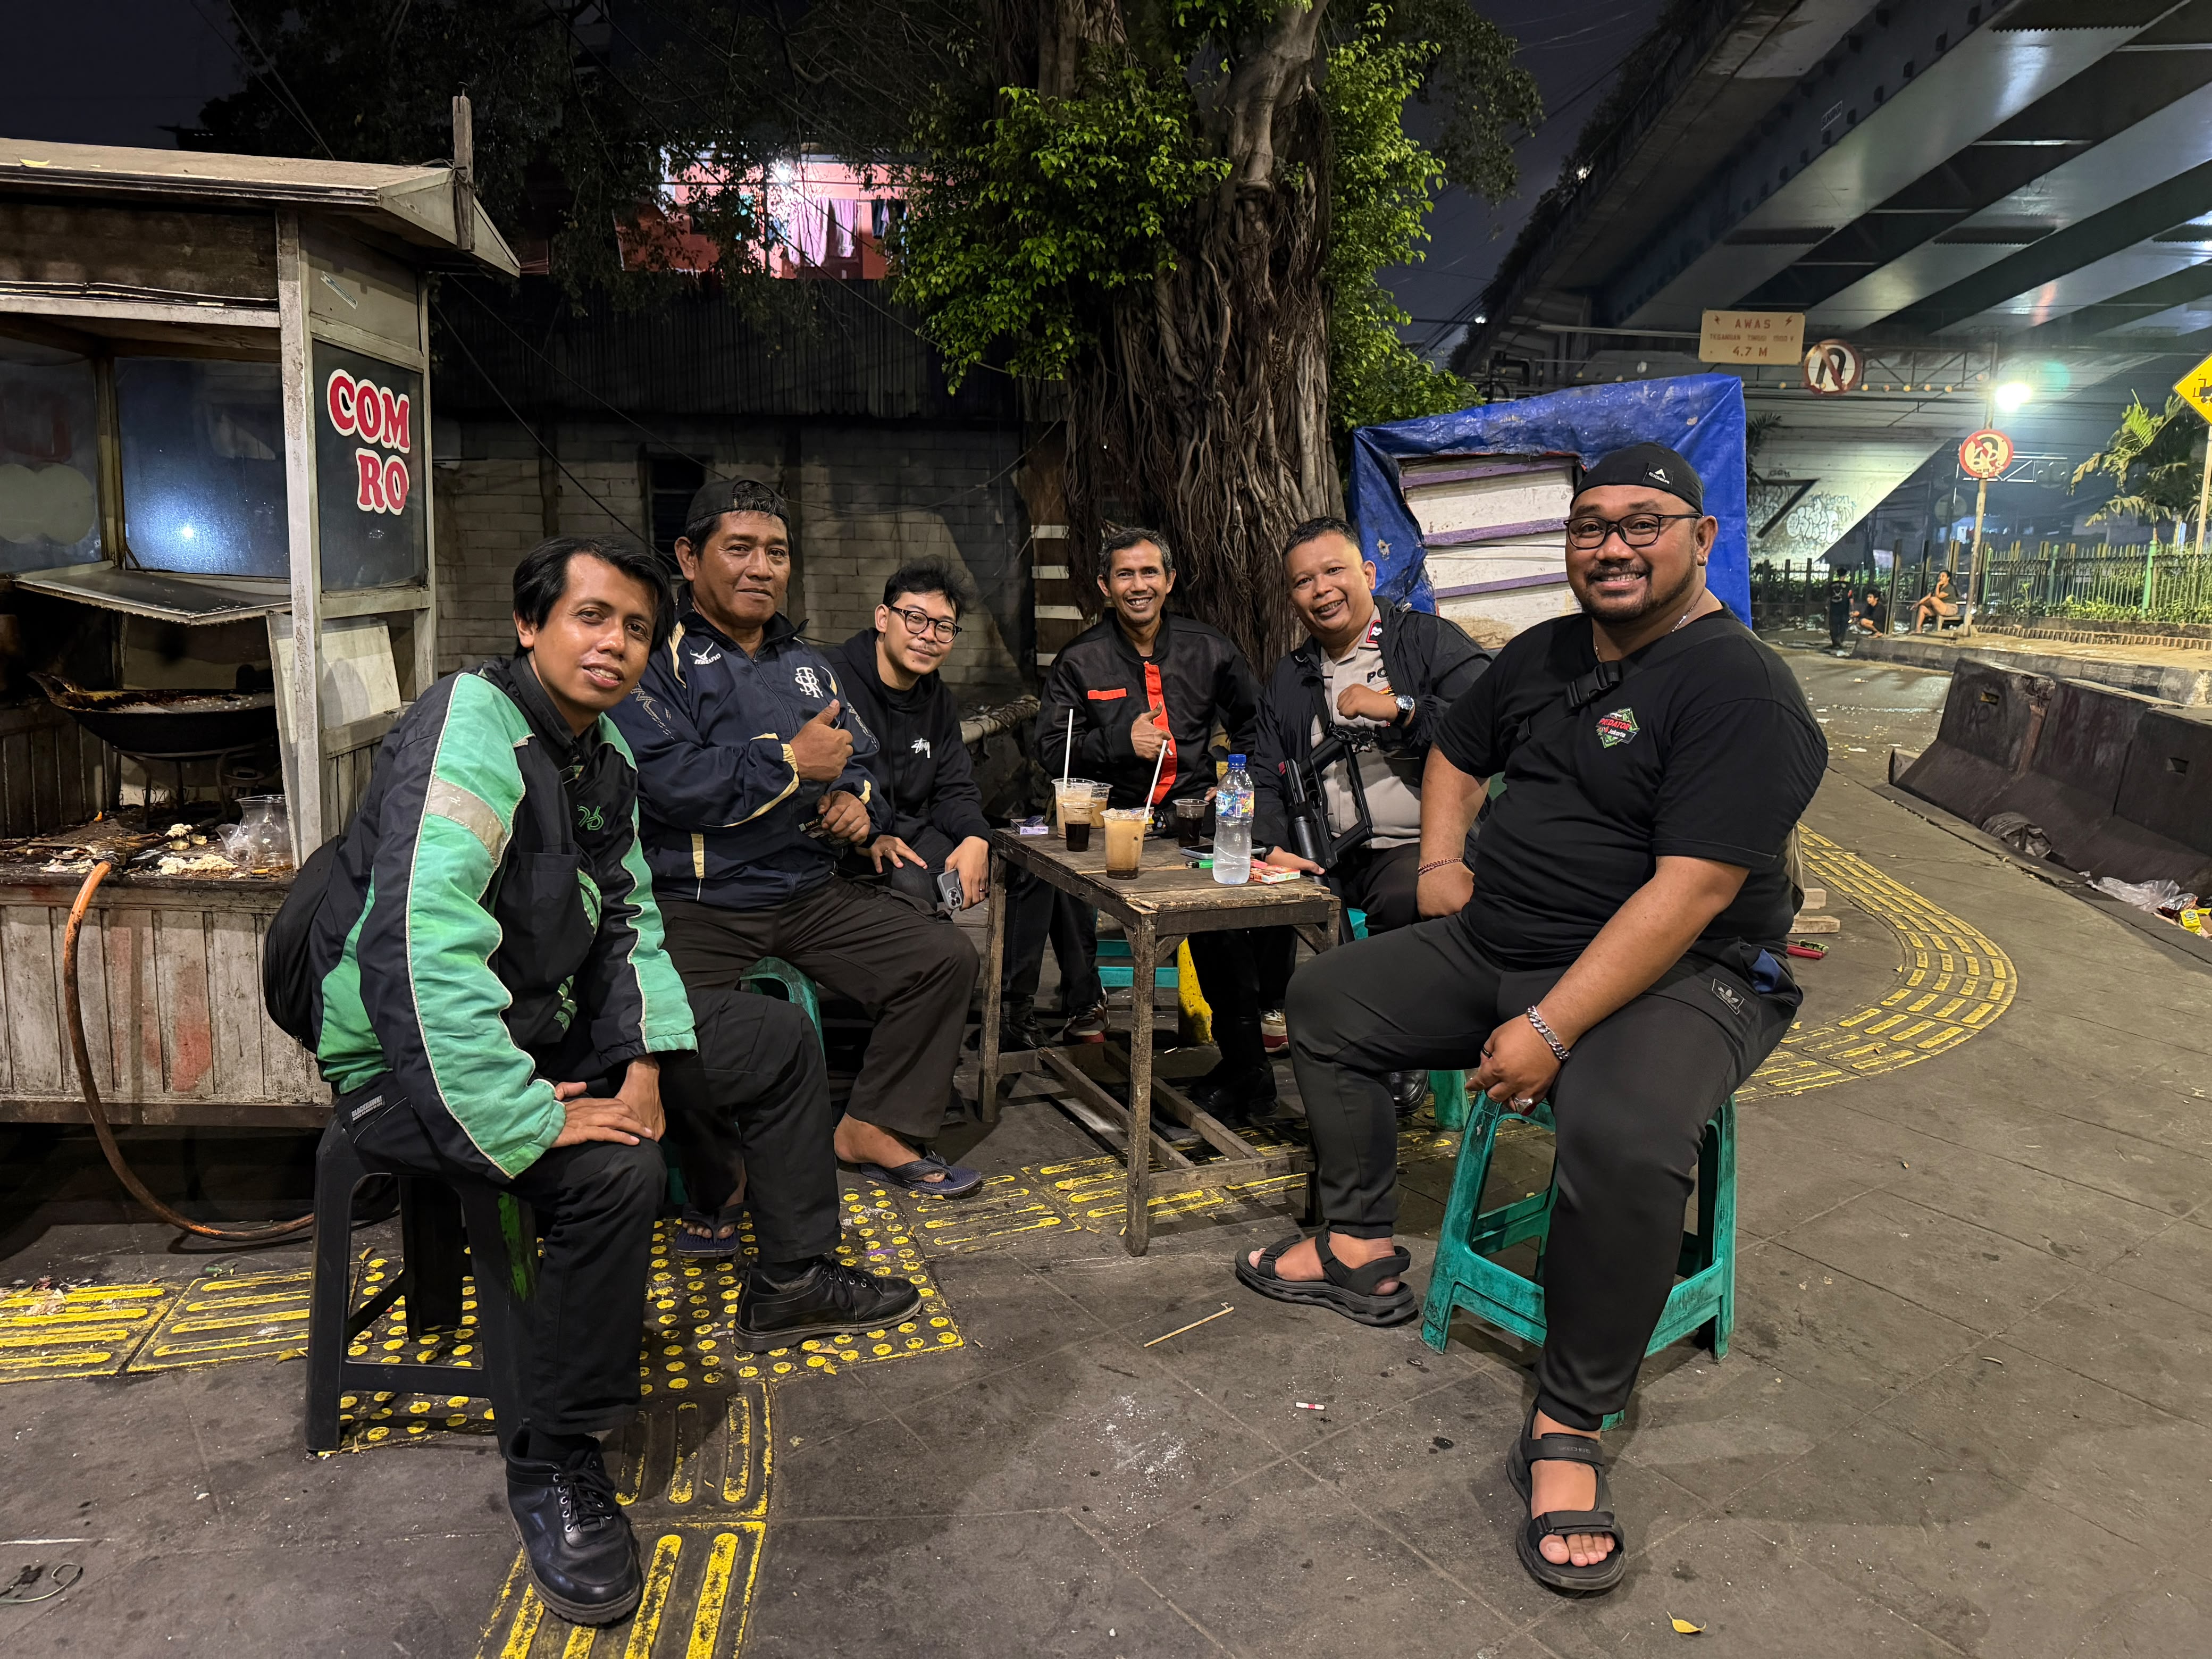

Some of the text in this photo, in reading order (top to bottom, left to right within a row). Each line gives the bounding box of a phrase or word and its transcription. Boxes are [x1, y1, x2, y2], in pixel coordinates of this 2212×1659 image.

[1735, 319, 1771, 329] AWAS
[1732, 346, 1768, 357] 4.7 M
[328, 369, 410, 454] COM
[356, 448, 409, 515] RO
[1648, 472, 1670, 484] EIGER
[1599, 718, 1630, 730] PREDATOR
[1608, 729, 1626, 738] Jakarta
